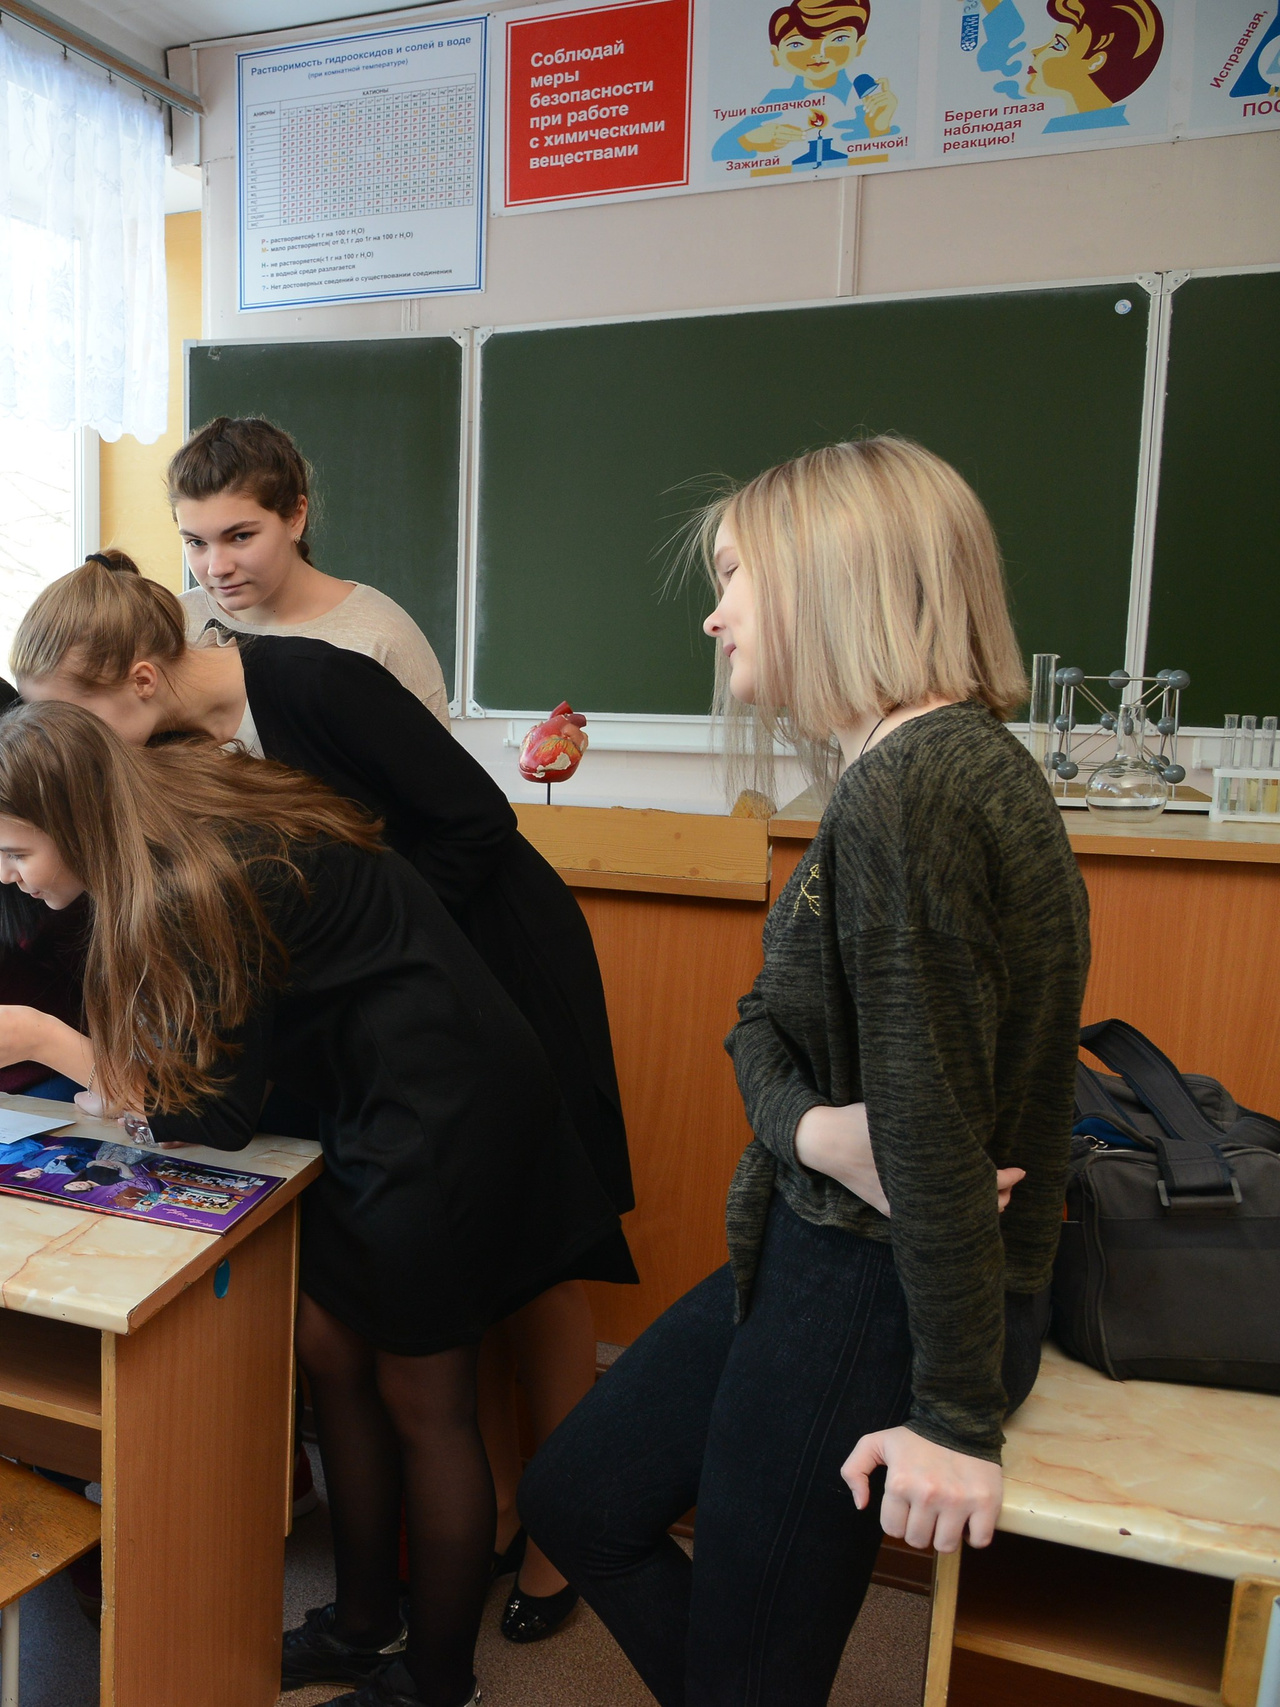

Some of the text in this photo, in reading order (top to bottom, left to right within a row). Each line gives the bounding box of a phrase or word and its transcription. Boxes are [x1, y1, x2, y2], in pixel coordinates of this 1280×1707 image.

[251, 60, 322, 76] Растворимость
[325, 48, 393, 64] гидрооксидов
[405, 41, 434, 52] солей
[447, 37, 471, 46] воде
[530, 39, 624, 67] Соблюдай
[1210, 10, 1268, 89] Исправная,
[308, 59, 408, 80] (при комнатной температуре)
[530, 70, 579, 88] меры
[362, 88, 389, 96] КАТИОНЫ
[530, 80, 654, 108] безопасности
[530, 104, 629, 130] при работе
[713, 96, 826, 120] Туши колпачком!
[945, 102, 1045, 122] Береги глаза
[529, 120, 665, 149] с химическими
[944, 119, 1022, 136] наблюдая
[847, 136, 909, 153] спичкой!
[943, 132, 1015, 153] реакцию!
[529, 144, 638, 169] веществами
[726, 156, 780, 171] Зажигай
[276, 269, 297, 277] водной
[299, 268, 317, 276] среде
[318, 264, 356, 273] разлагается
[282, 280, 323, 289] достоверных
[324, 277, 354, 285] сведений
[360, 272, 411, 282] существовании
[412, 269, 452, 277] соединения
